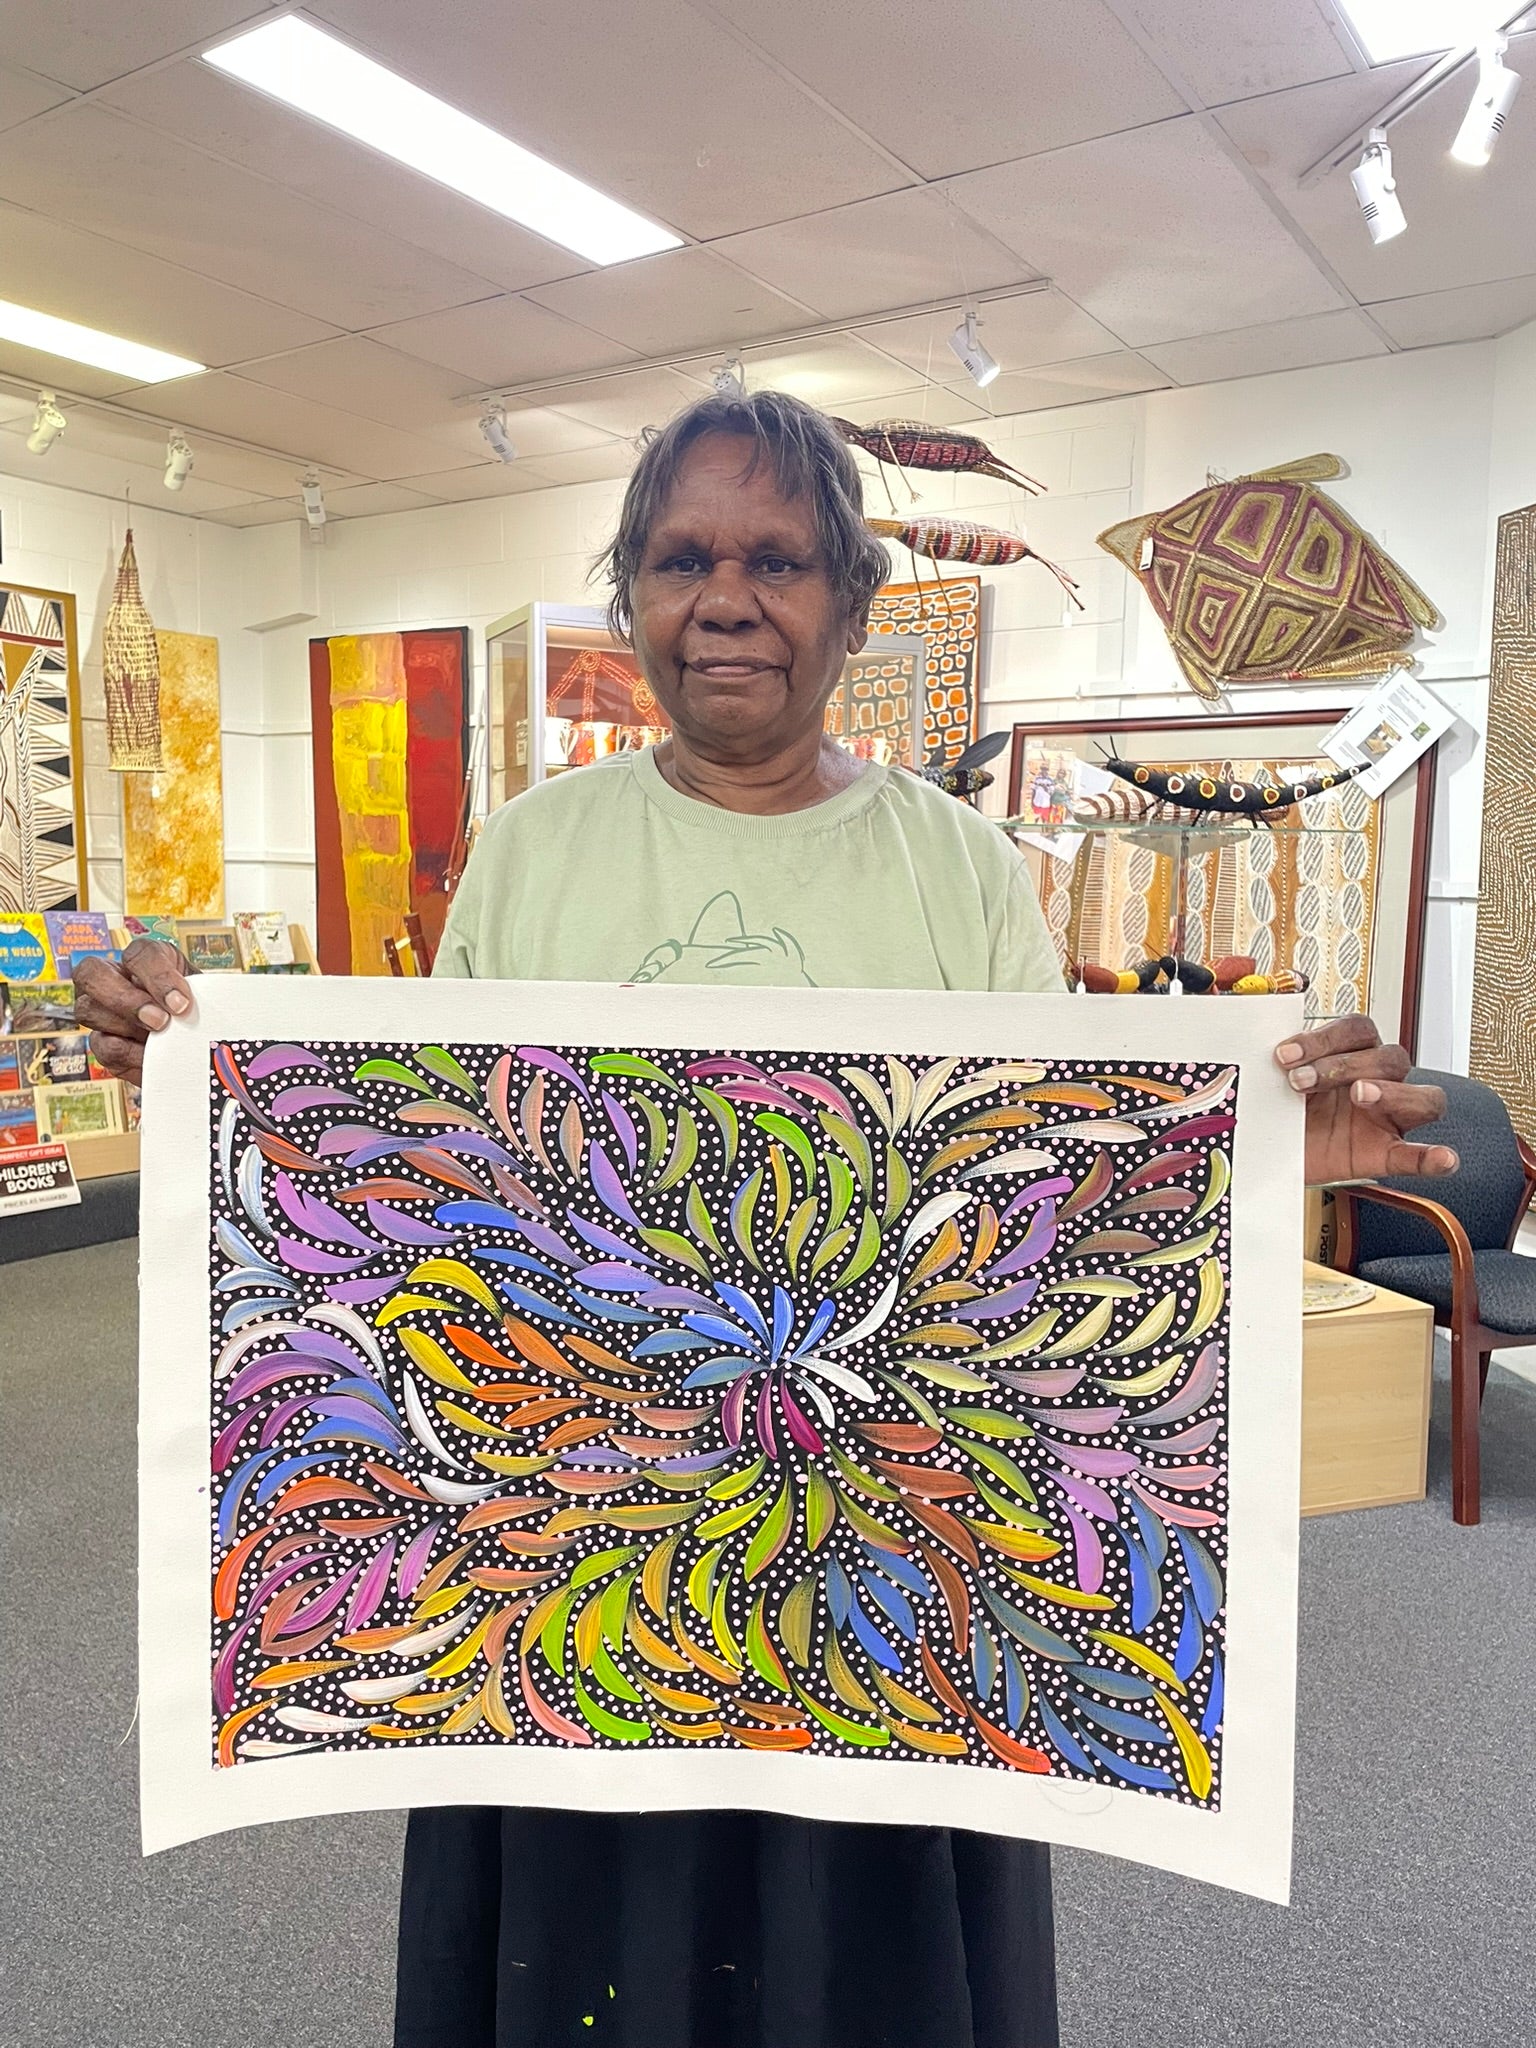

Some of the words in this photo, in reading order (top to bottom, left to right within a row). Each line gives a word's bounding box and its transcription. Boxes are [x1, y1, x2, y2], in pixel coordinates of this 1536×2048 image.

[11, 946, 43, 957] WORLD
[28, 1149, 43, 1158] GIFT
[0, 1160, 68, 1181] HILDREN'S
[6, 1174, 56, 1194] BOOKS
[1320, 1236, 1328, 1264] POST
